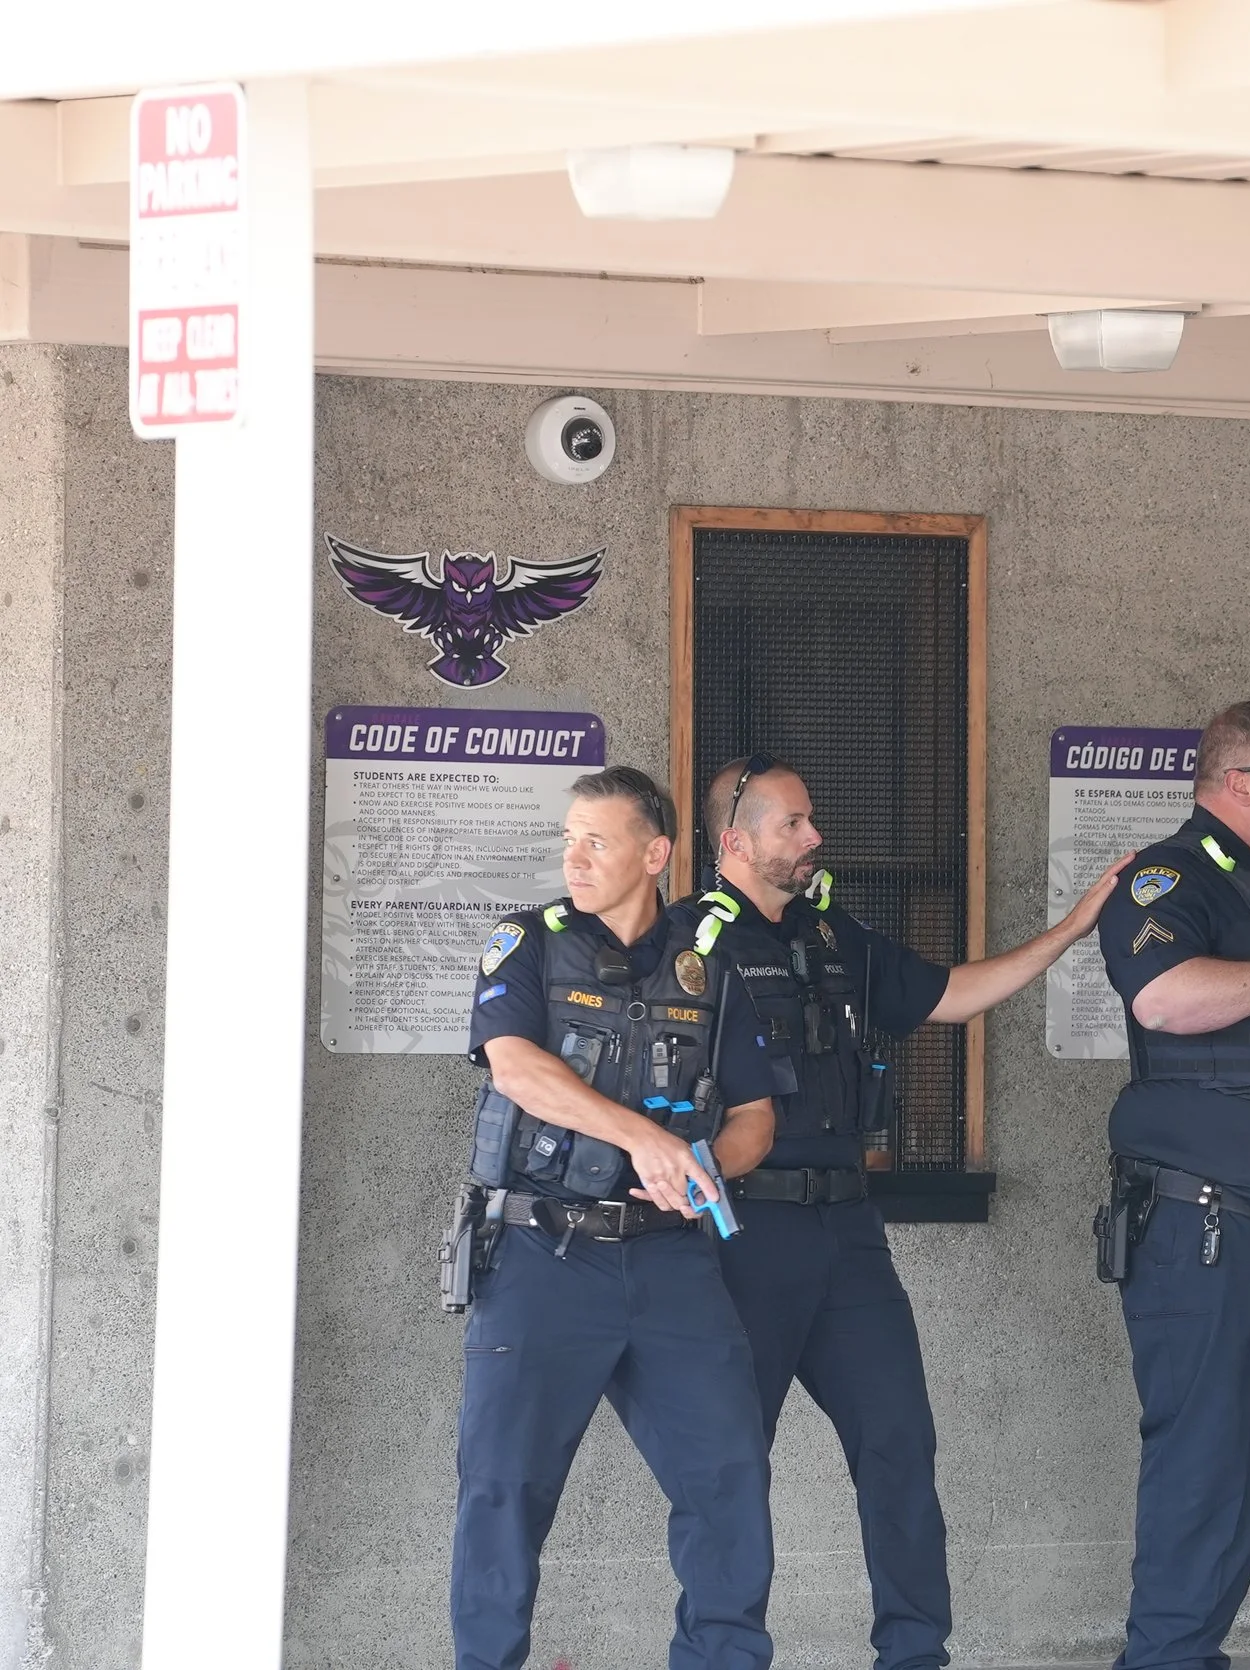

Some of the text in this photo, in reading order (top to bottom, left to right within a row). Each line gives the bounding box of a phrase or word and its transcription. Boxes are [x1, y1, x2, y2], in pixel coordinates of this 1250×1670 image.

[165, 103, 212, 156] NO
[139, 155, 238, 213] PARKING
[349, 724, 586, 758] CODE OF CONDUCT
[1066, 742, 1144, 771] CÓDIGO
[1149, 748, 1178, 771] DE
[353, 771, 498, 783] STUDENTS ARE EXPECTED TO:
[1074, 789, 1084, 797] SE
[1088, 789, 1121, 797] ESPERA
[1124, 790, 1143, 798] QUE
[1147, 790, 1163, 798] LOS
[1140, 868, 1176, 878] POLICE
[351, 900, 382, 908] EVERY
[385, 901, 479, 910] PARENT/GUARDIAN
[483, 903, 491, 911] IS
[567, 990, 604, 1008] JONES
[667, 1007, 699, 1022] POLICE
[539, 1139, 553, 1153] TQ
